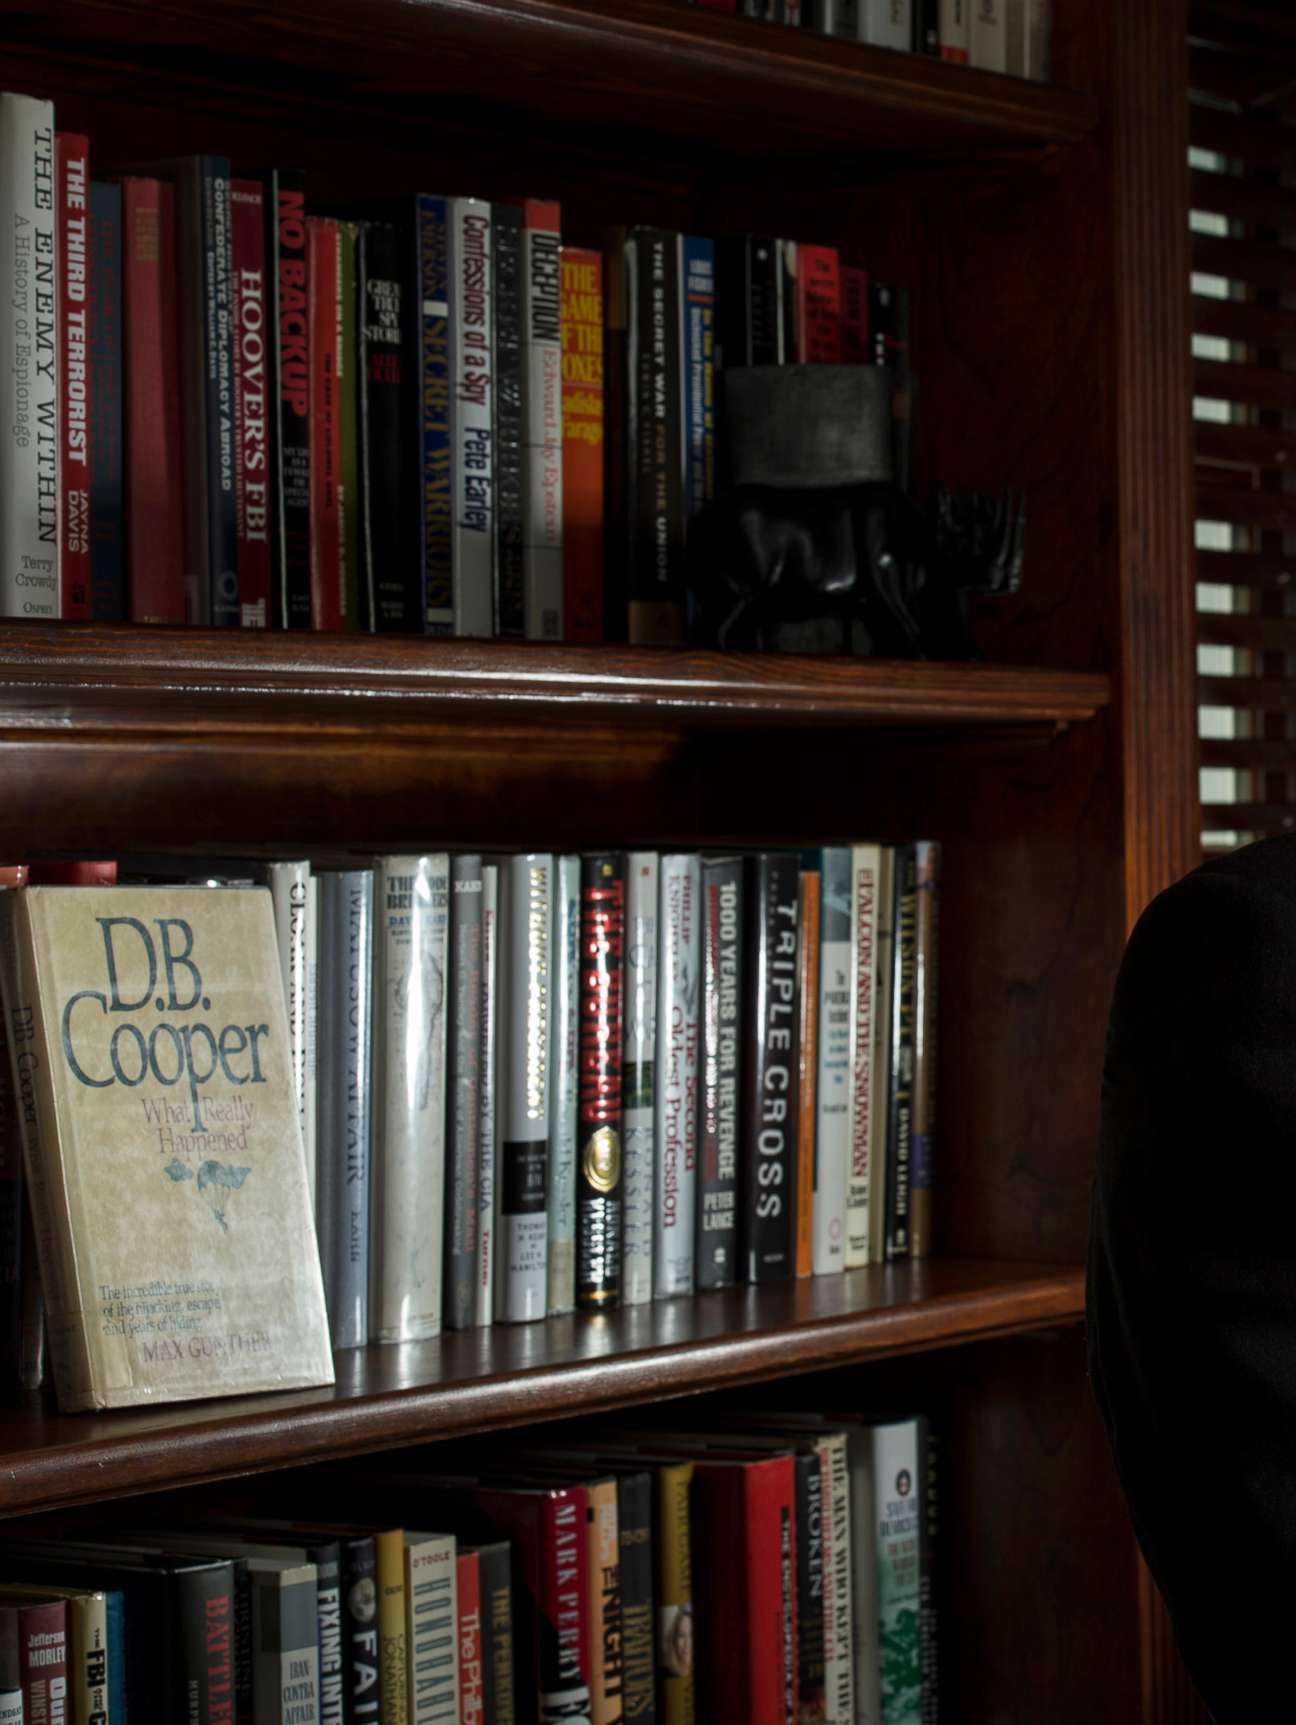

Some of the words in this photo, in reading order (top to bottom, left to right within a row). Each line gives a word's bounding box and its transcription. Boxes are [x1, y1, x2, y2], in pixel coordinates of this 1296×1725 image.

[34, 127, 54, 211] THE
[67, 158, 86, 210] THE
[15, 213, 31, 229] A
[214, 178, 226, 303] CONFEDERATE
[279, 189, 306, 250] NO
[11, 235, 32, 313] History
[67, 217, 87, 303] THIRD
[463, 215, 490, 327] Confessions
[531, 233, 562, 342] DECEPTION
[652, 242, 665, 281] THE
[15, 318, 33, 338] of
[35, 228, 56, 384] ENEMY
[280, 258, 309, 417] BACKUP
[653, 288, 667, 366] SECRET
[217, 309, 230, 411] DIPLOMACY
[241, 267, 266, 471] HOOVER'S
[421, 316, 450, 431] SECRET
[464, 332, 490, 352] of
[464, 355, 487, 368] a
[12, 342, 33, 447] Espionage
[68, 309, 88, 467] TERRORIST
[457, 371, 491, 406] Spy
[543, 350, 558, 427] Edward
[654, 373, 668, 419] WAR
[37, 400, 58, 547] WITHIN
[220, 417, 231, 491] ABROAD
[464, 427, 491, 470] Pete
[68, 490, 81, 553] DAVIS
[80, 489, 89, 555] JAYNA
[245, 480, 267, 543] FBI
[424, 447, 452, 611] WARRIORS
[458, 475, 492, 533] Earley
[541, 466, 559, 544] Epstein
[21, 556, 53, 573] Terry
[655, 517, 669, 584] UNION
[582, 880, 624, 959] THE
[720, 882, 737, 940] 1000
[856, 881, 875, 966] FALCON
[96, 916, 212, 1013] D.B.
[720, 945, 737, 1020] YEARS
[767, 899, 799, 1051] TRIPLE
[856, 972, 873, 1013] AND
[62, 989, 269, 1133] Cooper
[581, 969, 623, 1122] BUREAU
[686, 1023, 700, 1066] The
[720, 1026, 737, 1071] FOR
[855, 1022, 871, 1058] THE
[16, 1051, 38, 1128] Cooper
[142, 1097, 193, 1124] What
[200, 1096, 254, 1124] Really
[852, 1061, 870, 1178] SNOWMAN
[159, 1126, 249, 1162] Happened
[347, 1068, 367, 1185] AFFAIR
[480, 1130, 494, 1171] THE
[685, 1076, 699, 1171] Second
[719, 1077, 736, 1180] REVENGE
[756, 1064, 790, 1218] CROSS
[897, 1107, 910, 1162] DAVID
[479, 1176, 492, 1213] CIA
[624, 1127, 642, 1257] KESSLER
[663, 1097, 683, 1229] Profession
[896, 1164, 908, 1216] LEIGH
[703, 1191, 735, 1211] PETER
[703, 1210, 735, 1231] LANCE
[100, 1285, 121, 1301] The
[143, 1339, 184, 1363] MAX
[831, 1447, 847, 1494] THE
[554, 1502, 578, 1588] MARK
[780, 1518, 791, 1554] THE
[807, 1473, 823, 1599] BROKEN
[833, 1495, 850, 1543] MAN
[411, 1550, 452, 1568] O'TOOLE
[834, 1547, 851, 1600] WHO
[317, 1587, 343, 1674] FIXING
[461, 1606, 481, 1659] The
[491, 1585, 513, 1632] THE
[557, 1591, 582, 1681] PERRY
[602, 1584, 623, 1698] NIGHT
[782, 1558, 793, 1681] ENCYCLOPEDIA
[835, 1605, 852, 1661] KEPT
[87, 1650, 106, 1688] FBI
[282, 1681, 316, 1703] CONTRA
[622, 1601, 656, 1719] TRAITORS
[285, 1703, 316, 1725] AFFAIR
[837, 1671, 852, 1716] THE
